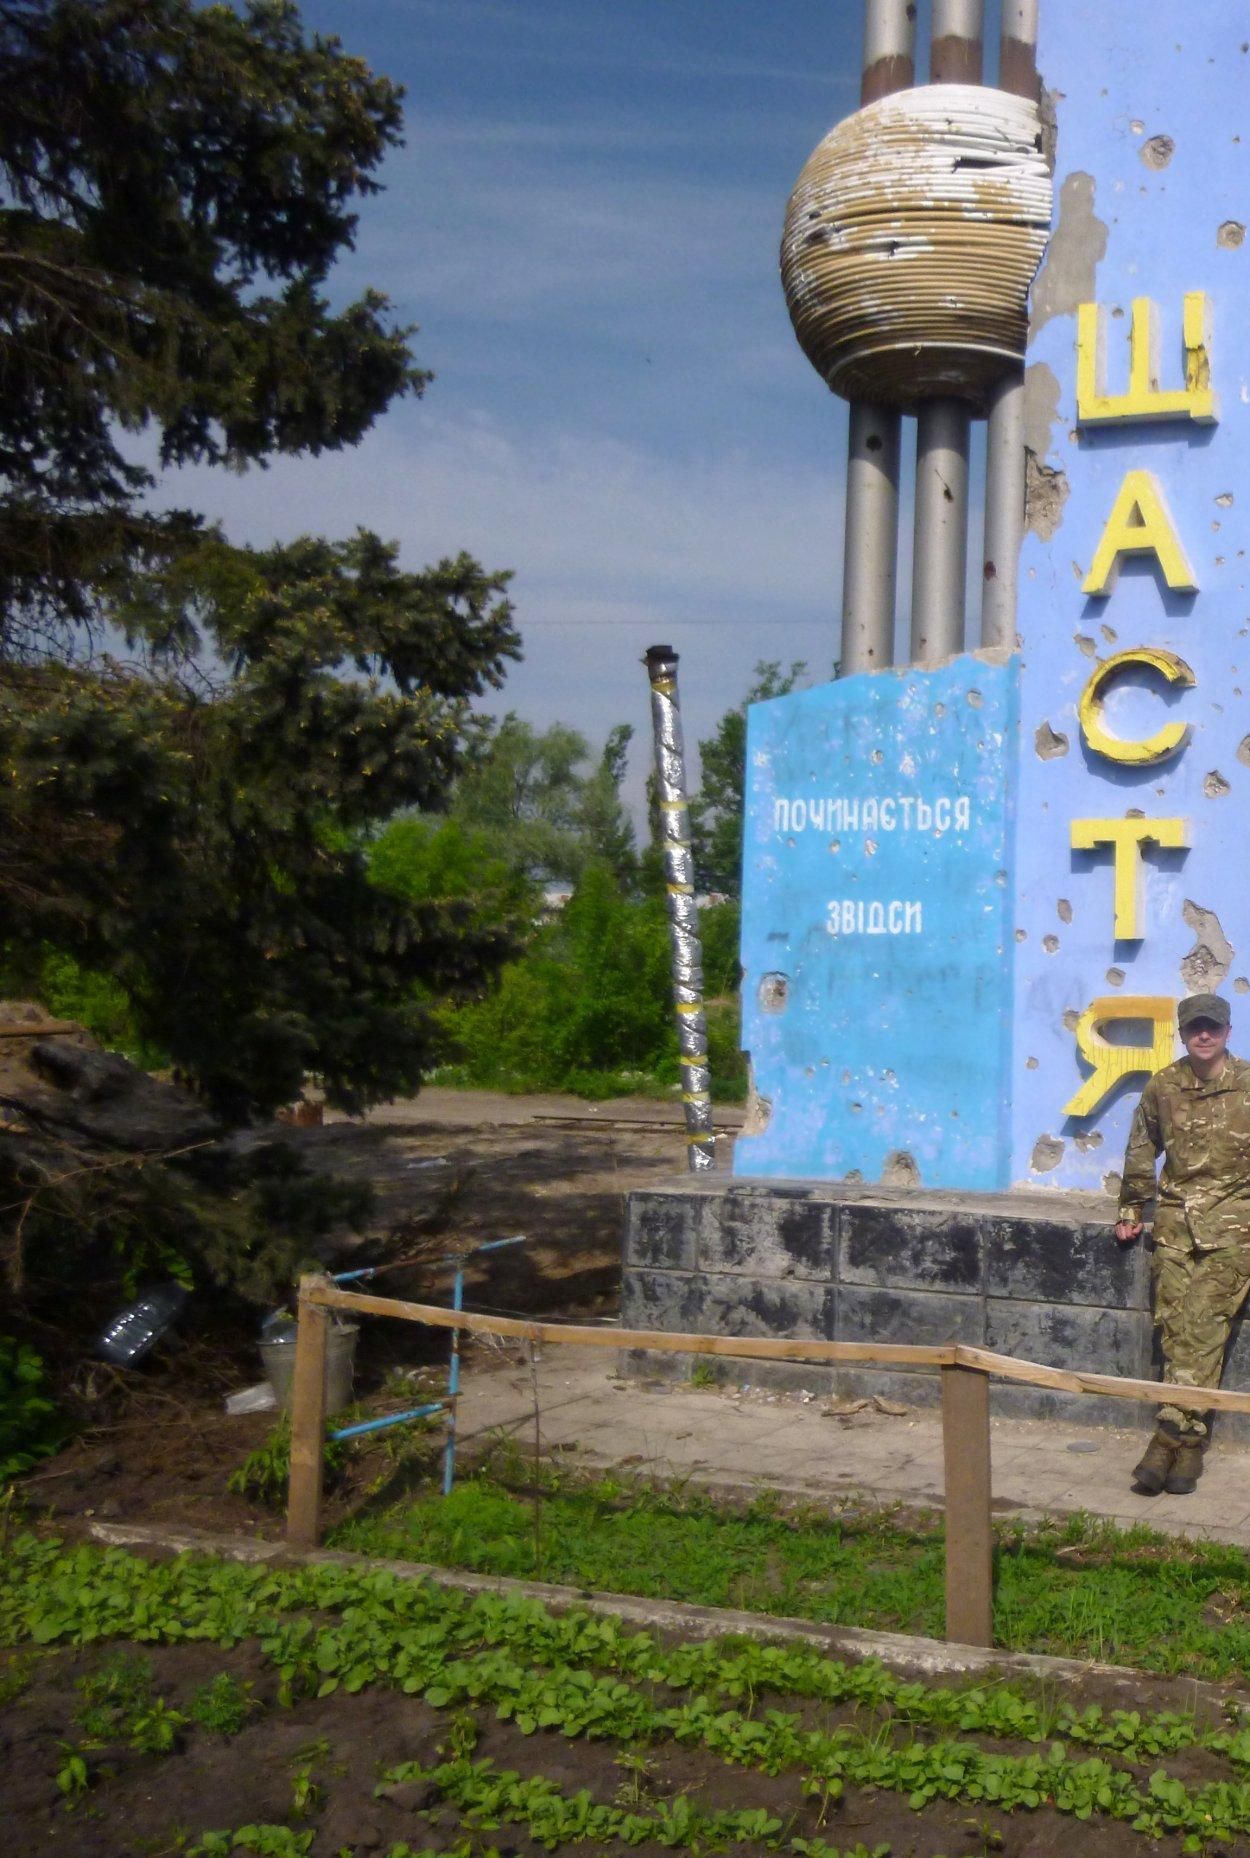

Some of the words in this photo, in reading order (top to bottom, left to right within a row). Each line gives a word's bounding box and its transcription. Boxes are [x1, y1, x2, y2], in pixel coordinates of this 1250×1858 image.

[1062, 291, 1217, 1117] ЩАСТЯ
[774, 797, 970, 832] ПОЧИНАЄТЬСЯ
[826, 900, 922, 934] ЗВІДСИ
